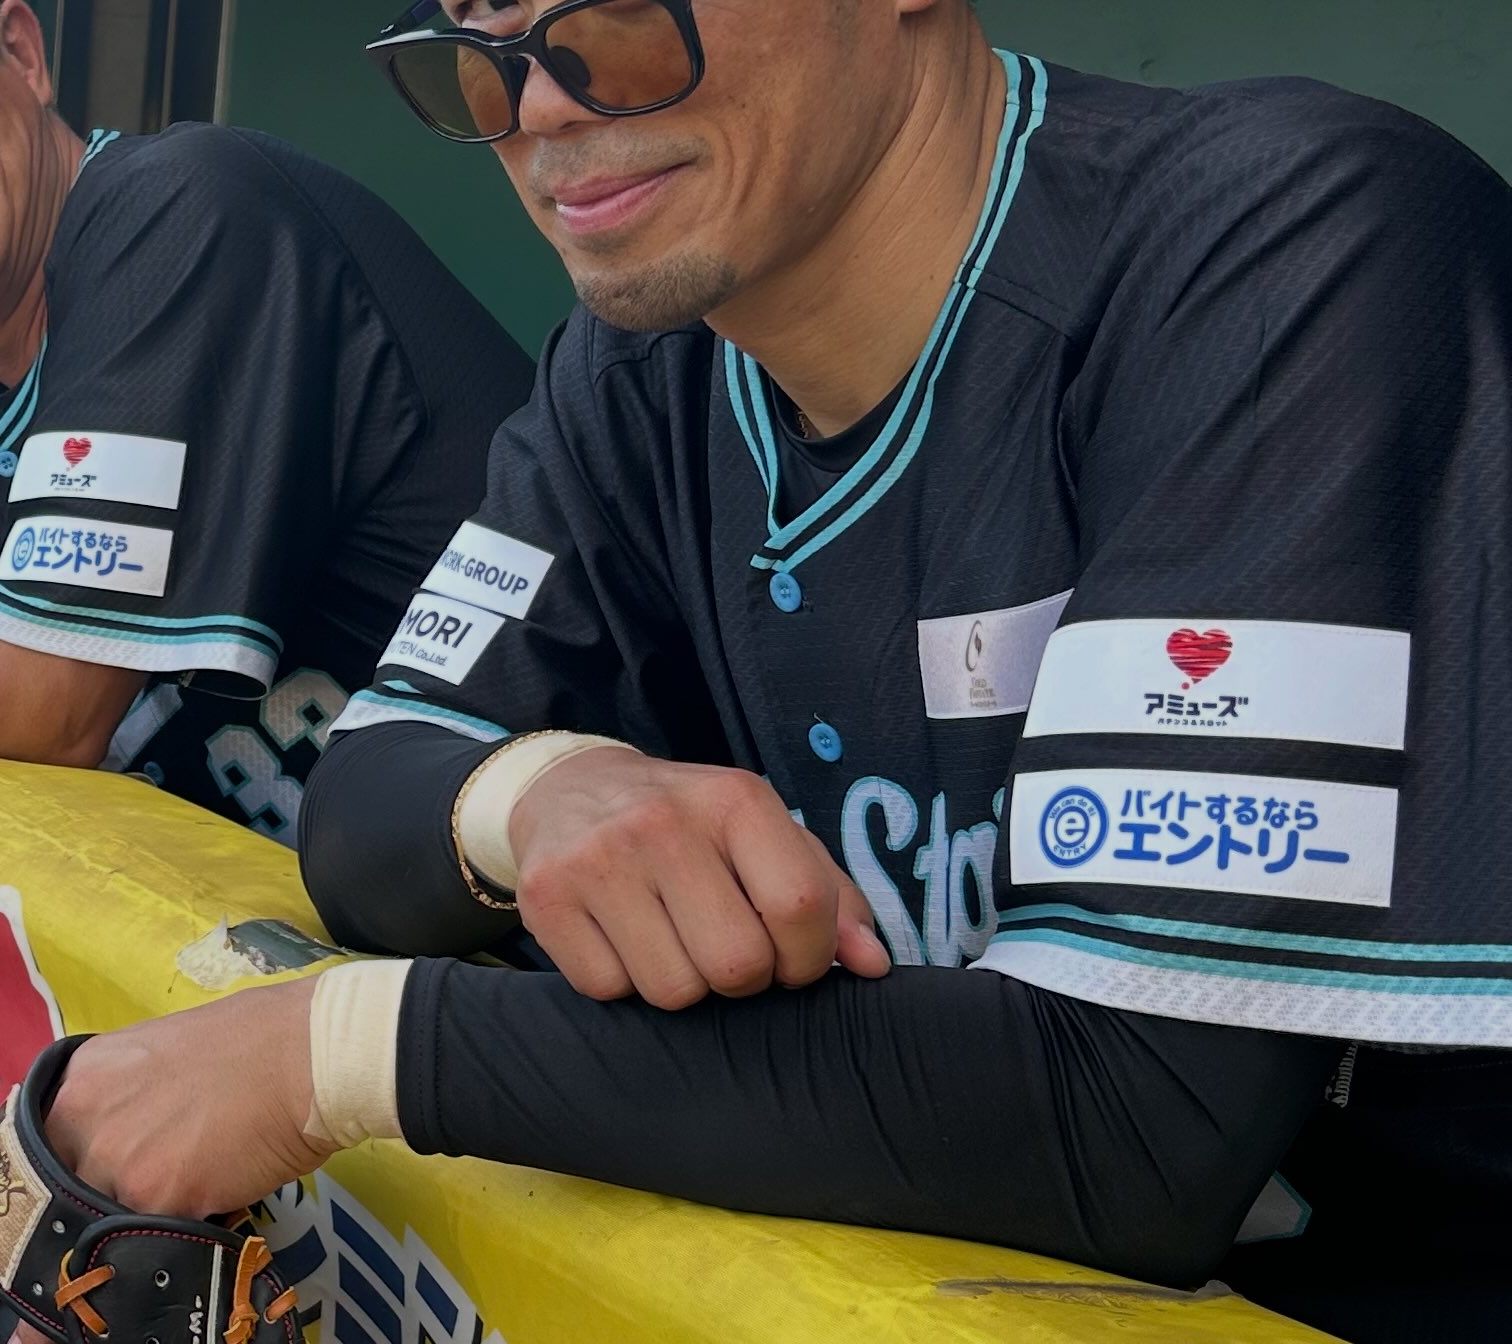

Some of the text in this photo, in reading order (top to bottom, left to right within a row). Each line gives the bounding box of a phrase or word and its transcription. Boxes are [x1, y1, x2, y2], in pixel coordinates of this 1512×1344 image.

[50, 474, 96, 487] アミューズ
[39, 527, 128, 553] バイトするなら
[33, 546, 143, 576] エントリー
[1144, 693, 1248, 717] アミューズ
[1120, 789, 1319, 831] バイトするなら
[1053, 843, 1087, 857] ENTRY
[1113, 822, 1351, 874] エントリー
[840, 775, 1005, 968] Sta
